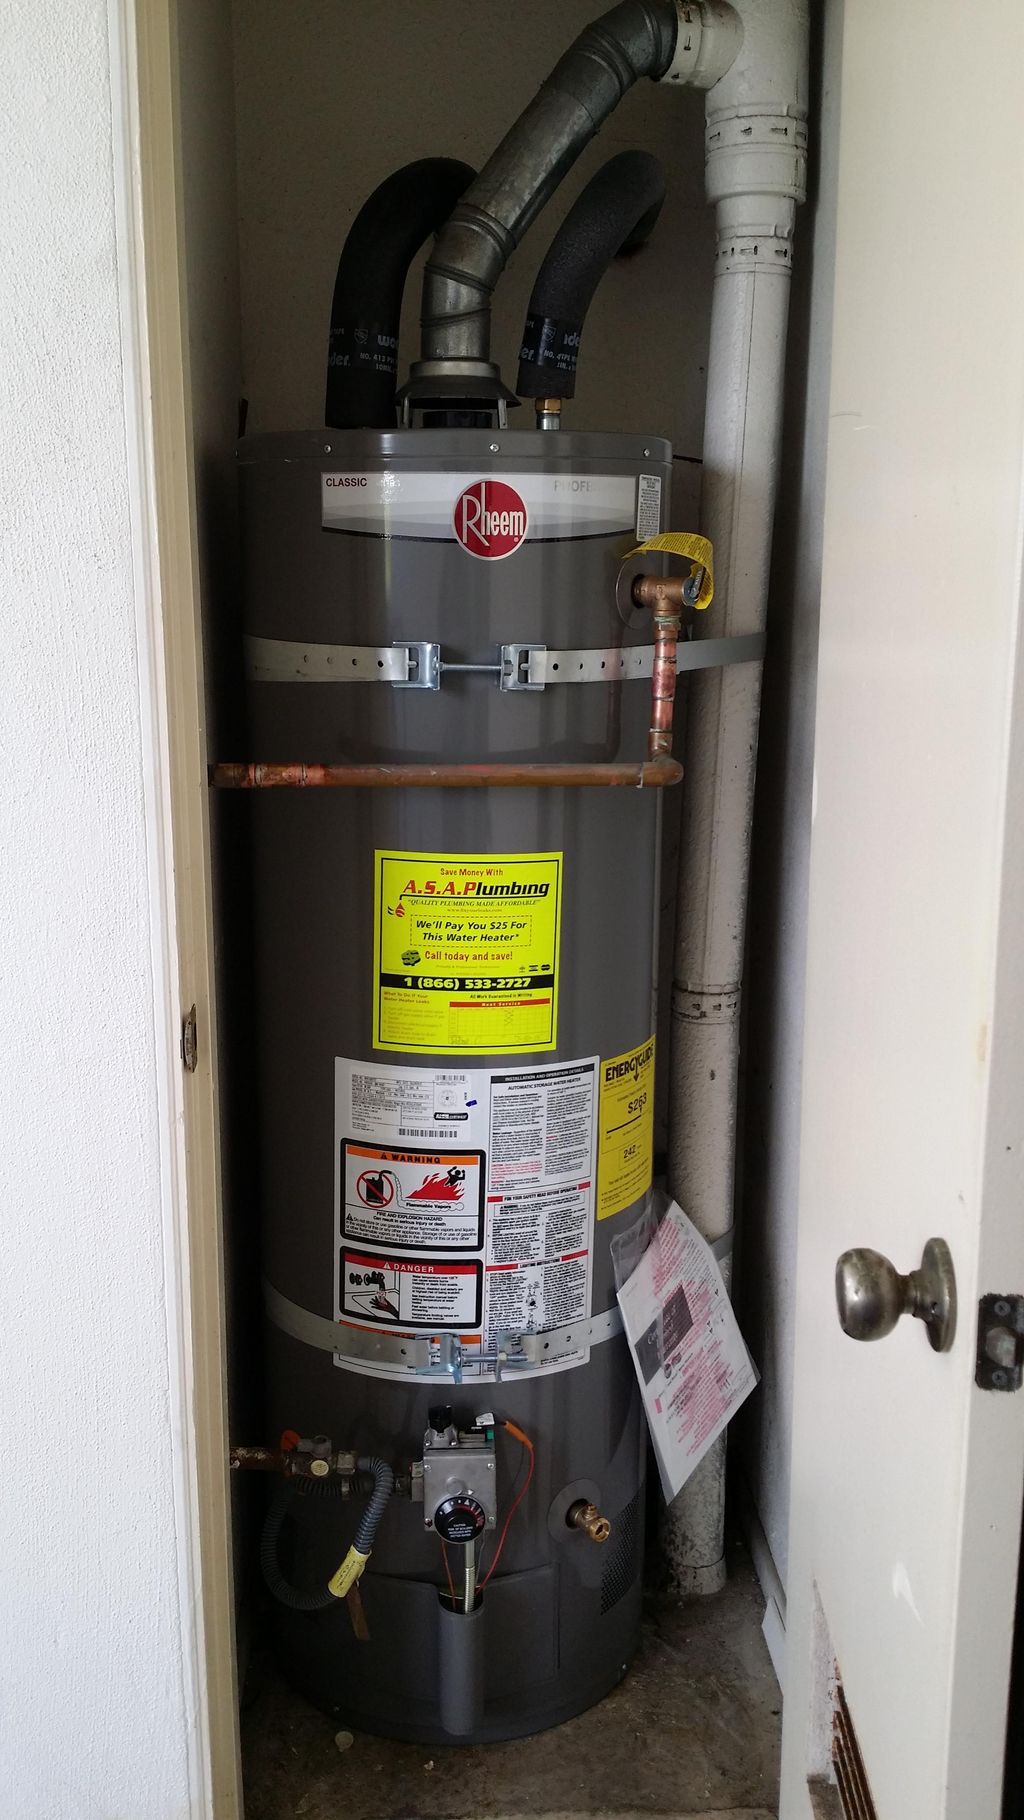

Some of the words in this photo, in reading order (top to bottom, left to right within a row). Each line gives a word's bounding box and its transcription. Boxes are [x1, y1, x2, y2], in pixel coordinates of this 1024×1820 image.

[326, 478, 368, 488] CLASSIC
[462, 482, 525, 546] Rheem
[440, 868, 458, 876] Save
[459, 869, 484, 877] Money
[416, 920, 442, 929] We'll
[445, 922, 463, 931] Pay
[510, 921, 527, 929] For
[422, 932, 443, 941] This
[425, 951, 441, 960] Call
[445, 952, 469, 961] today
[472, 952, 488, 960] and
[491, 952, 513, 960] save!
[404, 978, 412, 987] 1
[417, 978, 459, 989] (866)
[465, 978, 531, 988] 533-2727
[391, 1154, 440, 1164] WARNING
[394, 1264, 434, 1273] DANGER
